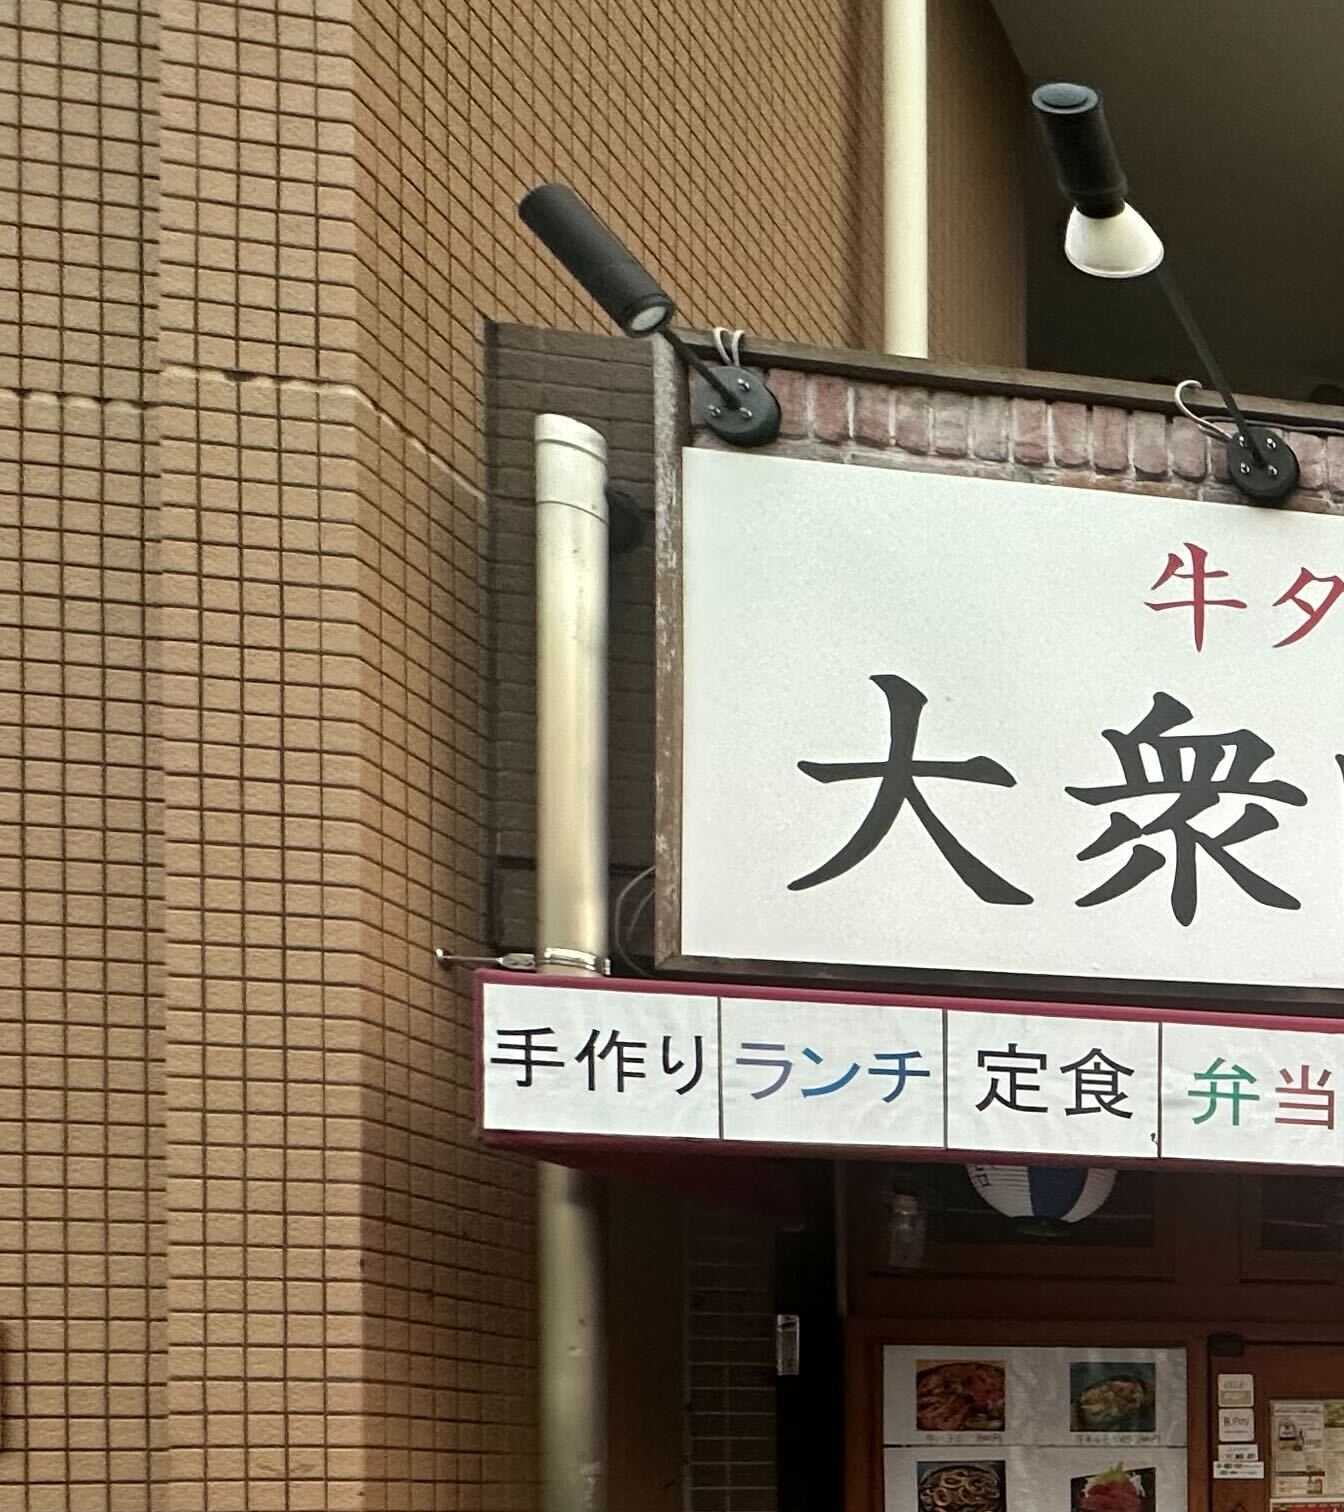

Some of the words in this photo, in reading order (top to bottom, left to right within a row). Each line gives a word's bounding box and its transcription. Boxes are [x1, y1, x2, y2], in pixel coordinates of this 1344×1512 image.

[490, 1025, 703, 1096] 手作り
[735, 1041, 930, 1103] ランチ
[975, 1042, 1137, 1120] 定食
[1188, 1057, 1335, 1130] 弁当
